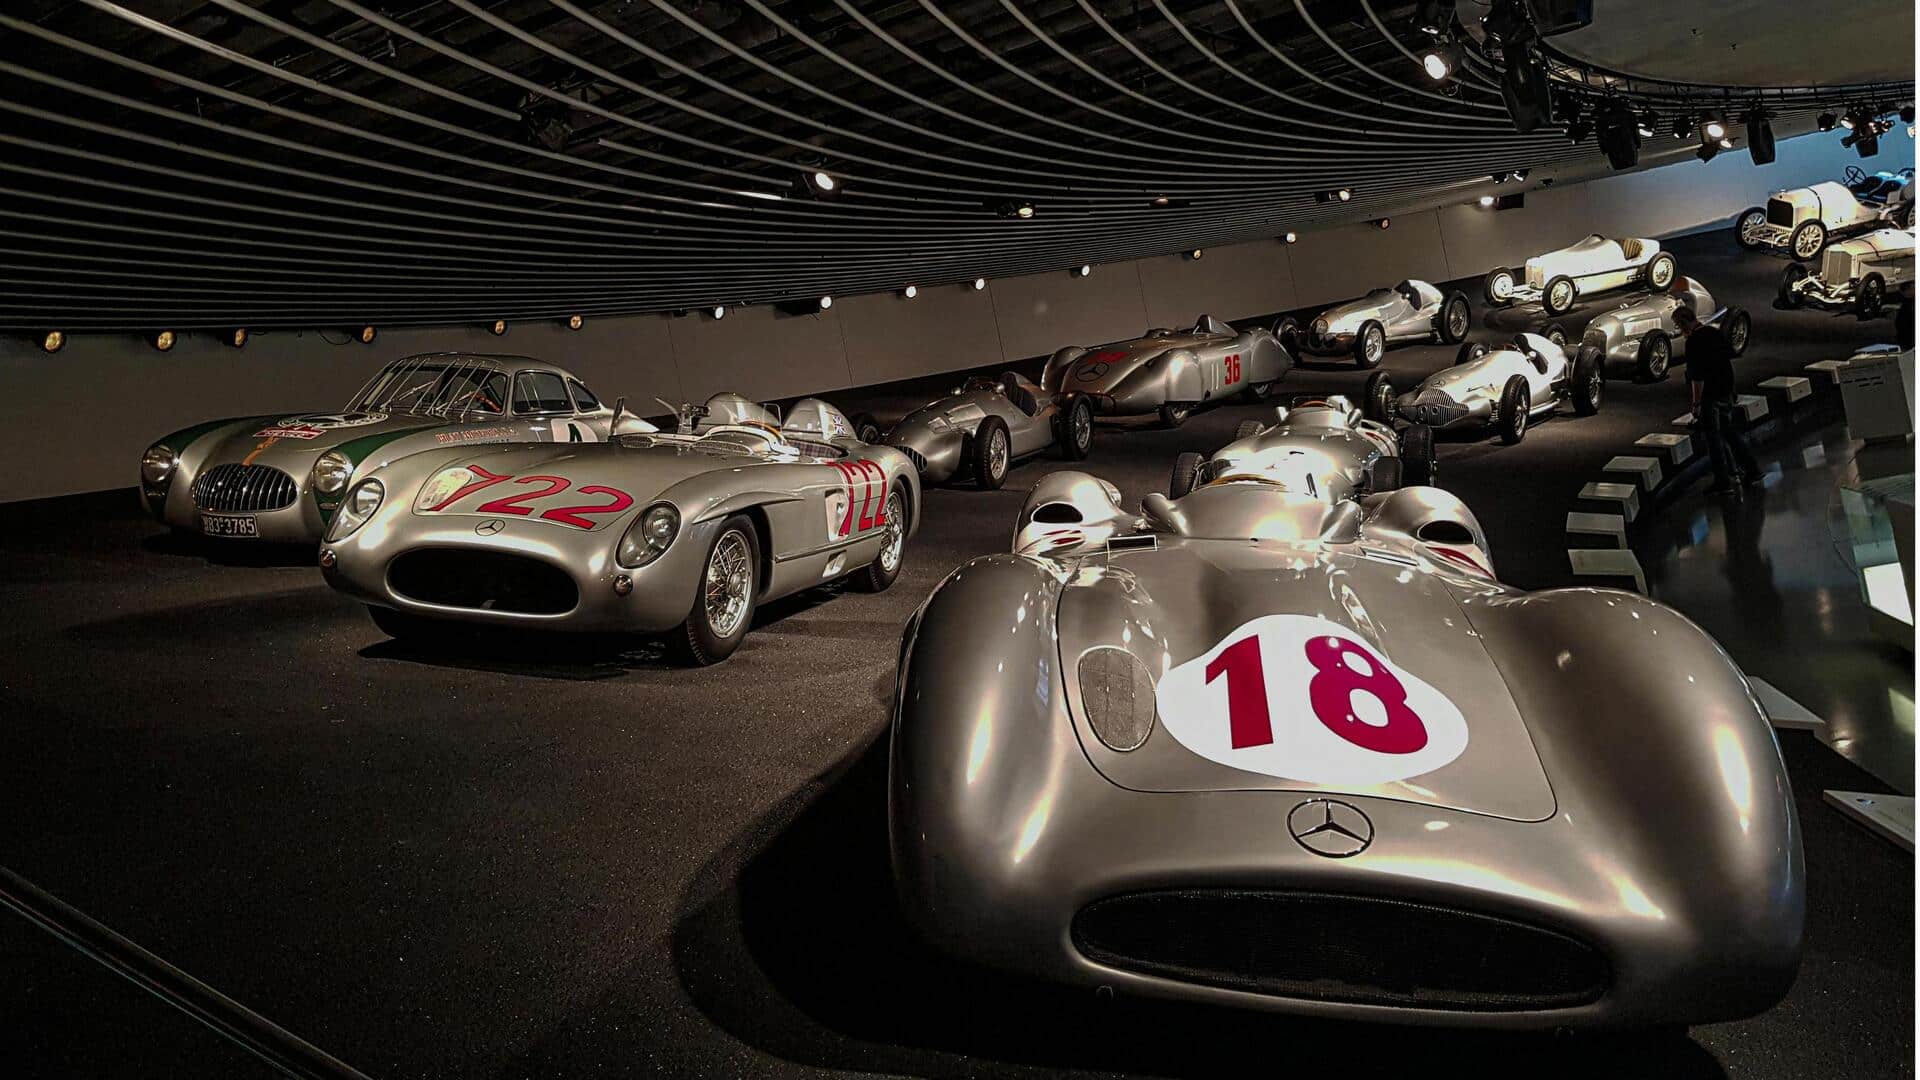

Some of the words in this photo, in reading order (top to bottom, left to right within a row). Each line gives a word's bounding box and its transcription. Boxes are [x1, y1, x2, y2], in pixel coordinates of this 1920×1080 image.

[1224, 354, 1241, 385] 36
[426, 464, 634, 530] 722
[824, 458, 888, 537] 722
[1205, 633, 1428, 755] 18
